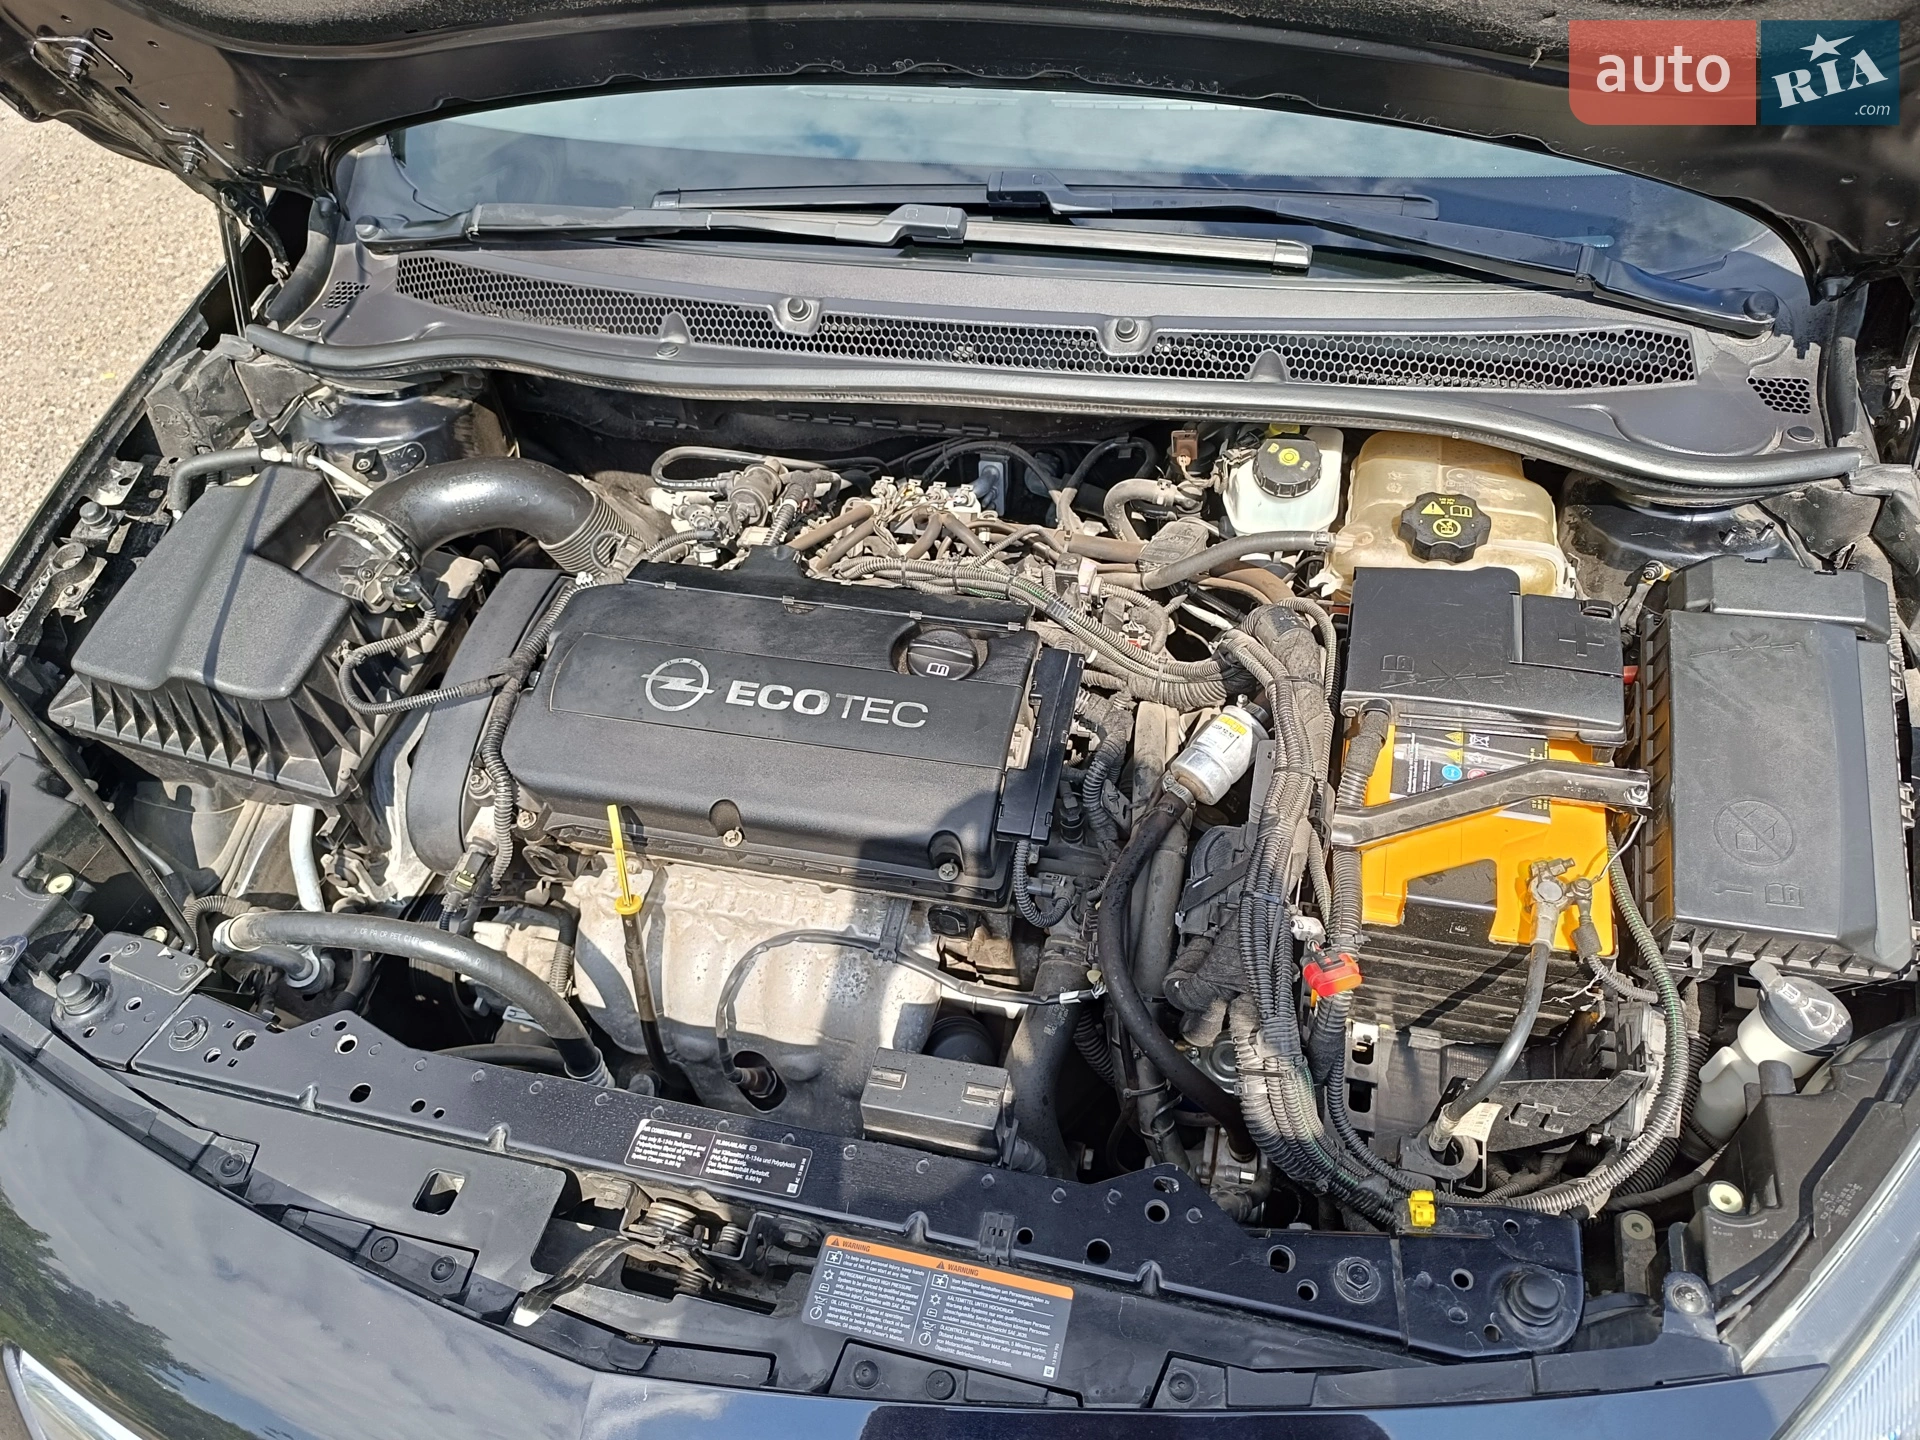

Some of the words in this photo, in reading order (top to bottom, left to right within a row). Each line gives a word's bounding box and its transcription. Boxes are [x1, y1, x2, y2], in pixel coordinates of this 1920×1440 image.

[725, 680, 929, 728] ECOTEC
[842, 1240, 871, 1252] WARNING
[948, 1264, 979, 1276] WARNUNG
